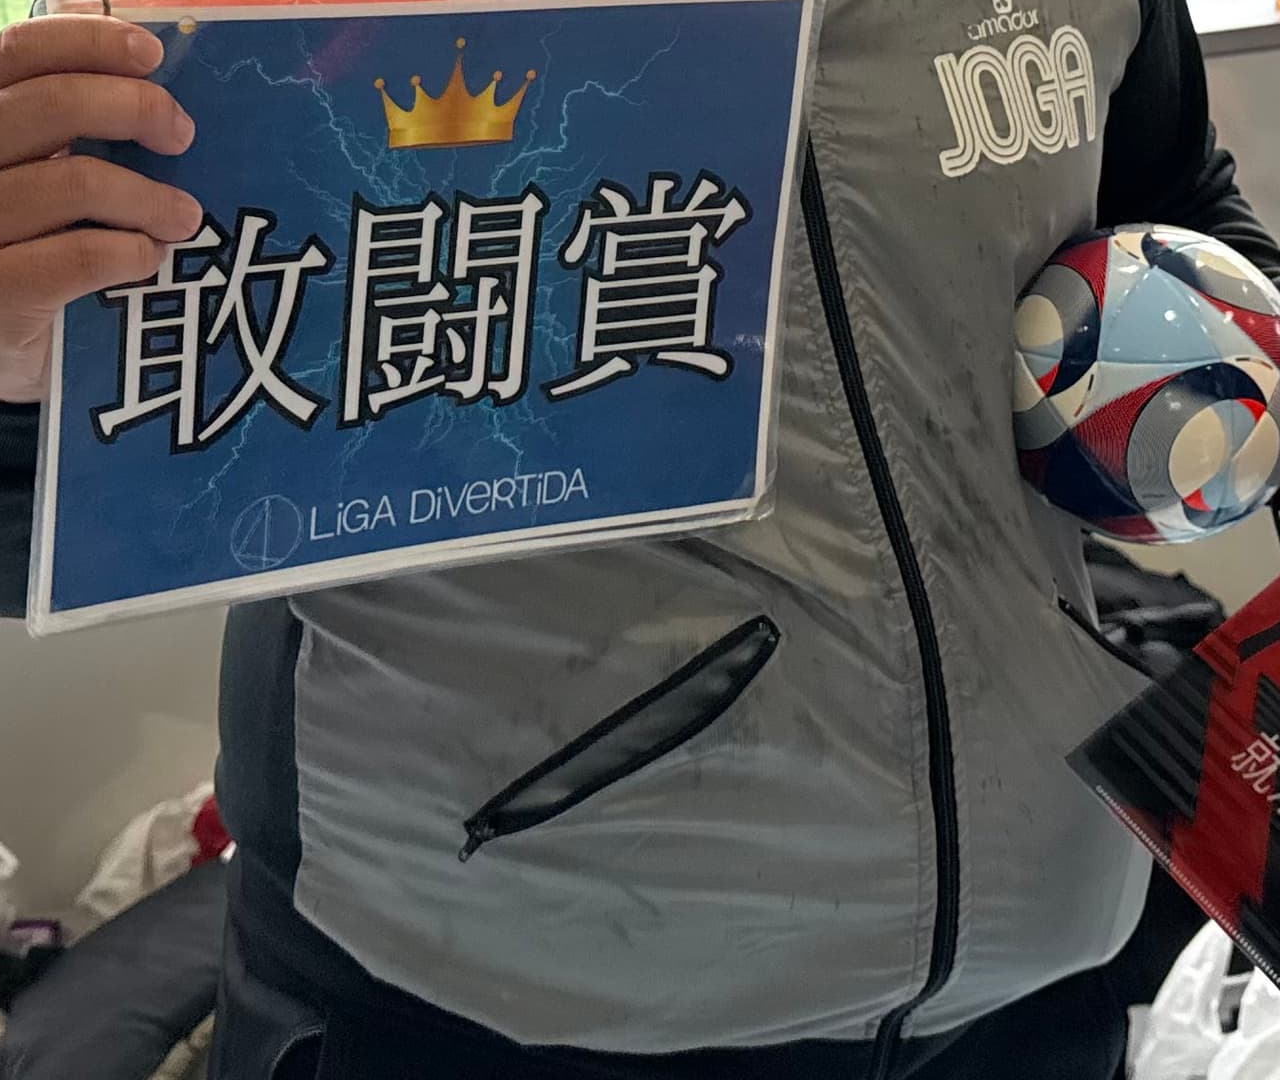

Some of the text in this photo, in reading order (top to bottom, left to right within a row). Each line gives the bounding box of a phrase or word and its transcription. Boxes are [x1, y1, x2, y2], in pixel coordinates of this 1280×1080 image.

[934, 25, 1097, 177] JOGA
[97, 173, 750, 450] 敢闘賞
